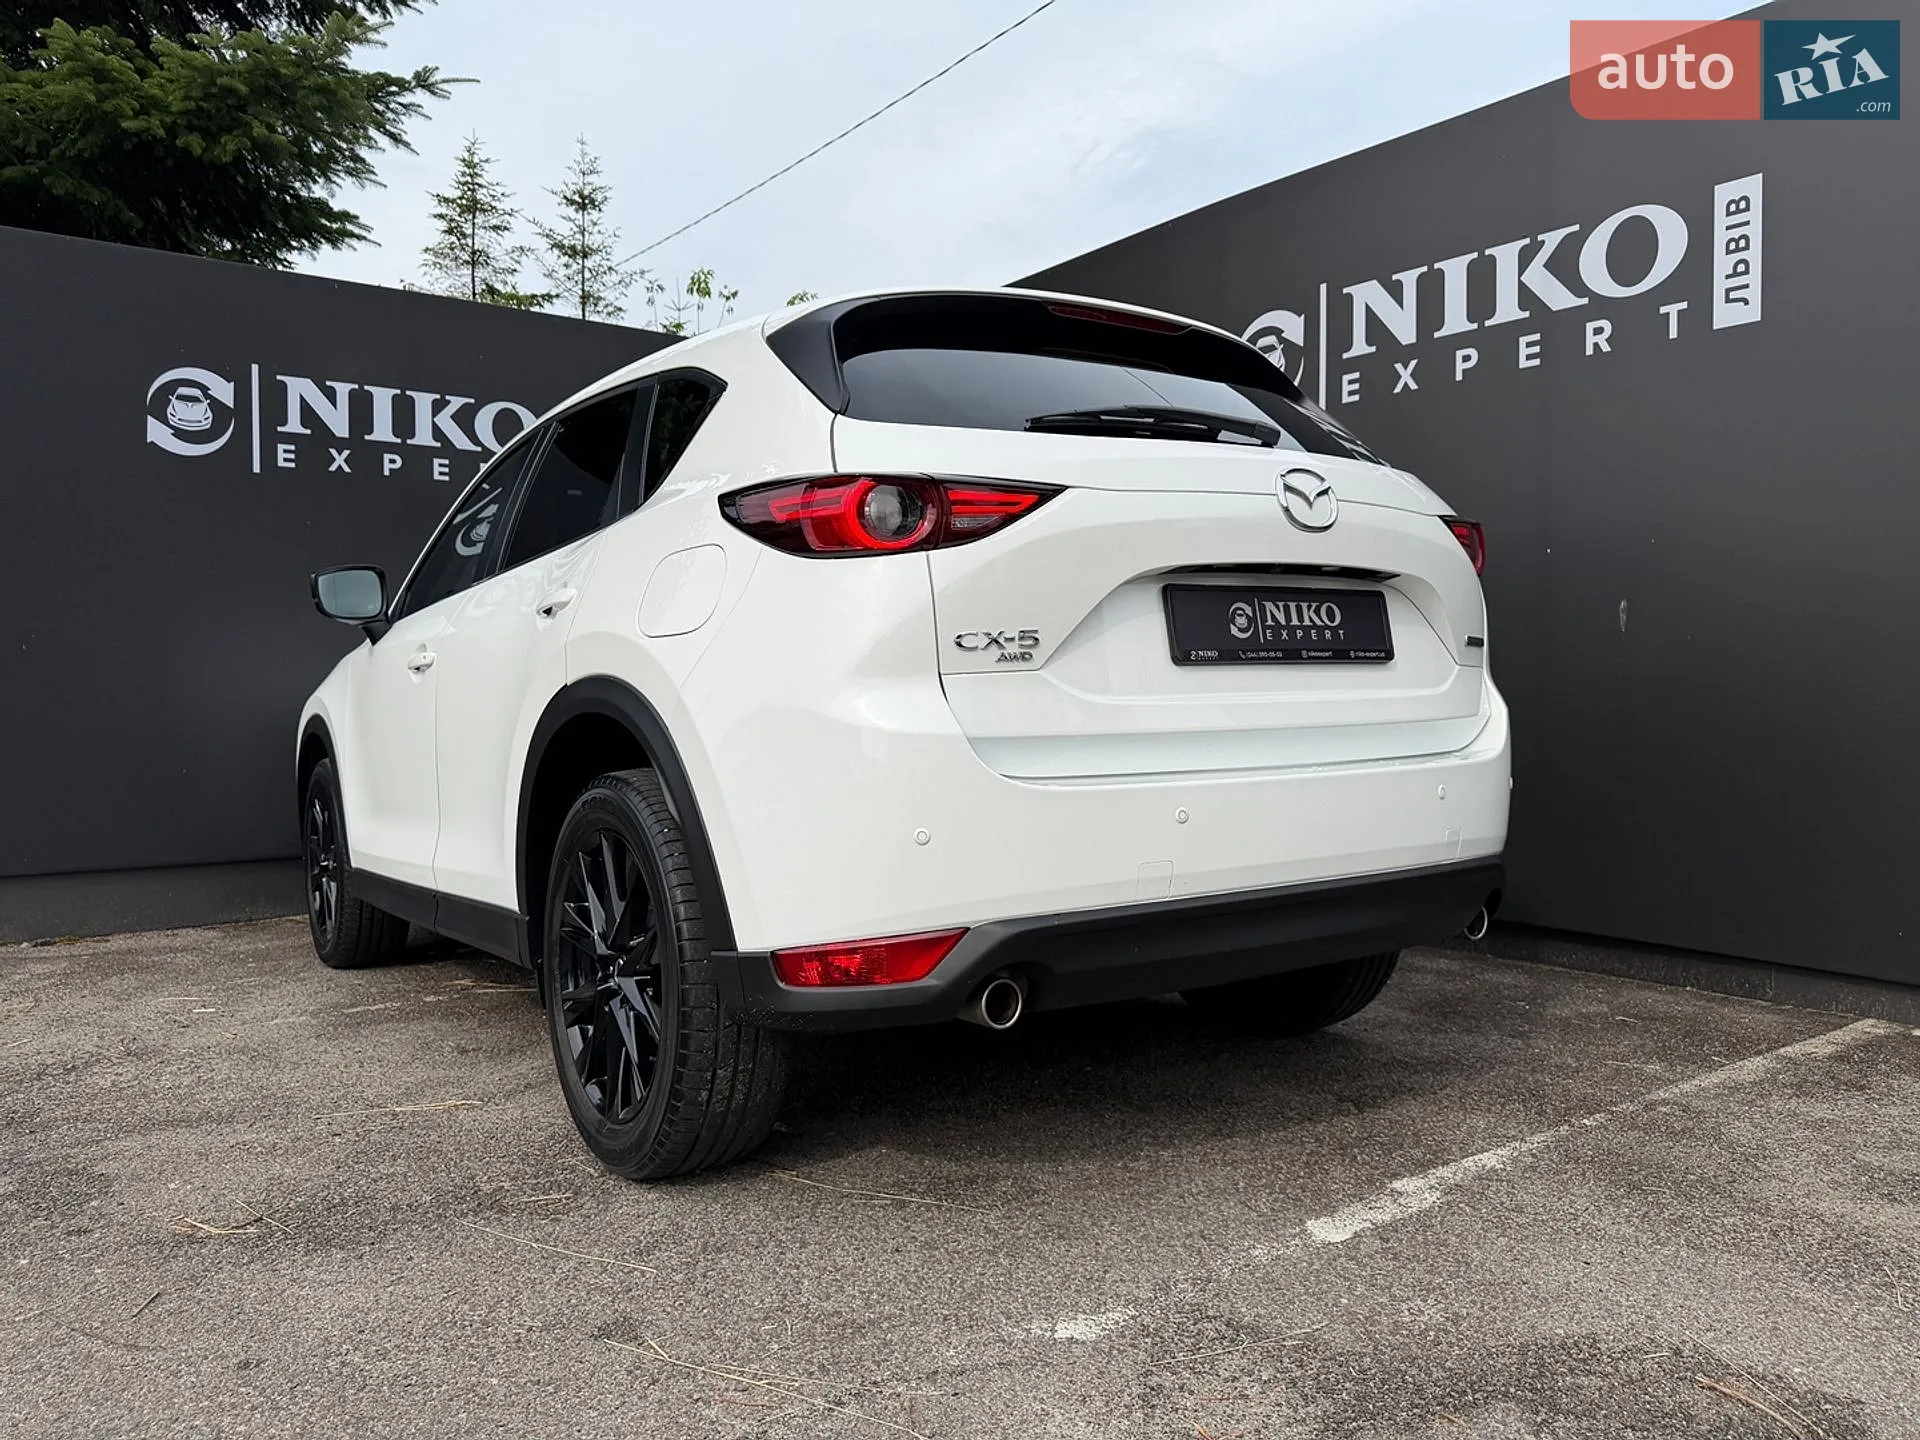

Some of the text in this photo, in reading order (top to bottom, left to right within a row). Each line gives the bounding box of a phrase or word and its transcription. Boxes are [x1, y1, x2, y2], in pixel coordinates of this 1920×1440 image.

[1724, 193, 1752, 308] ЛЬВІВ
[1342, 203, 1689, 360] NIKO
[1341, 300, 1689, 404] EXPERT
[276, 374, 537, 454] NIKO
[277, 443, 491, 481] EXPE
[1262, 601, 1342, 628] NIKO
[954, 629, 1040, 652] CX-5
[1266, 629, 1345, 641] EXPERT
[995, 650, 1034, 664] AWD
